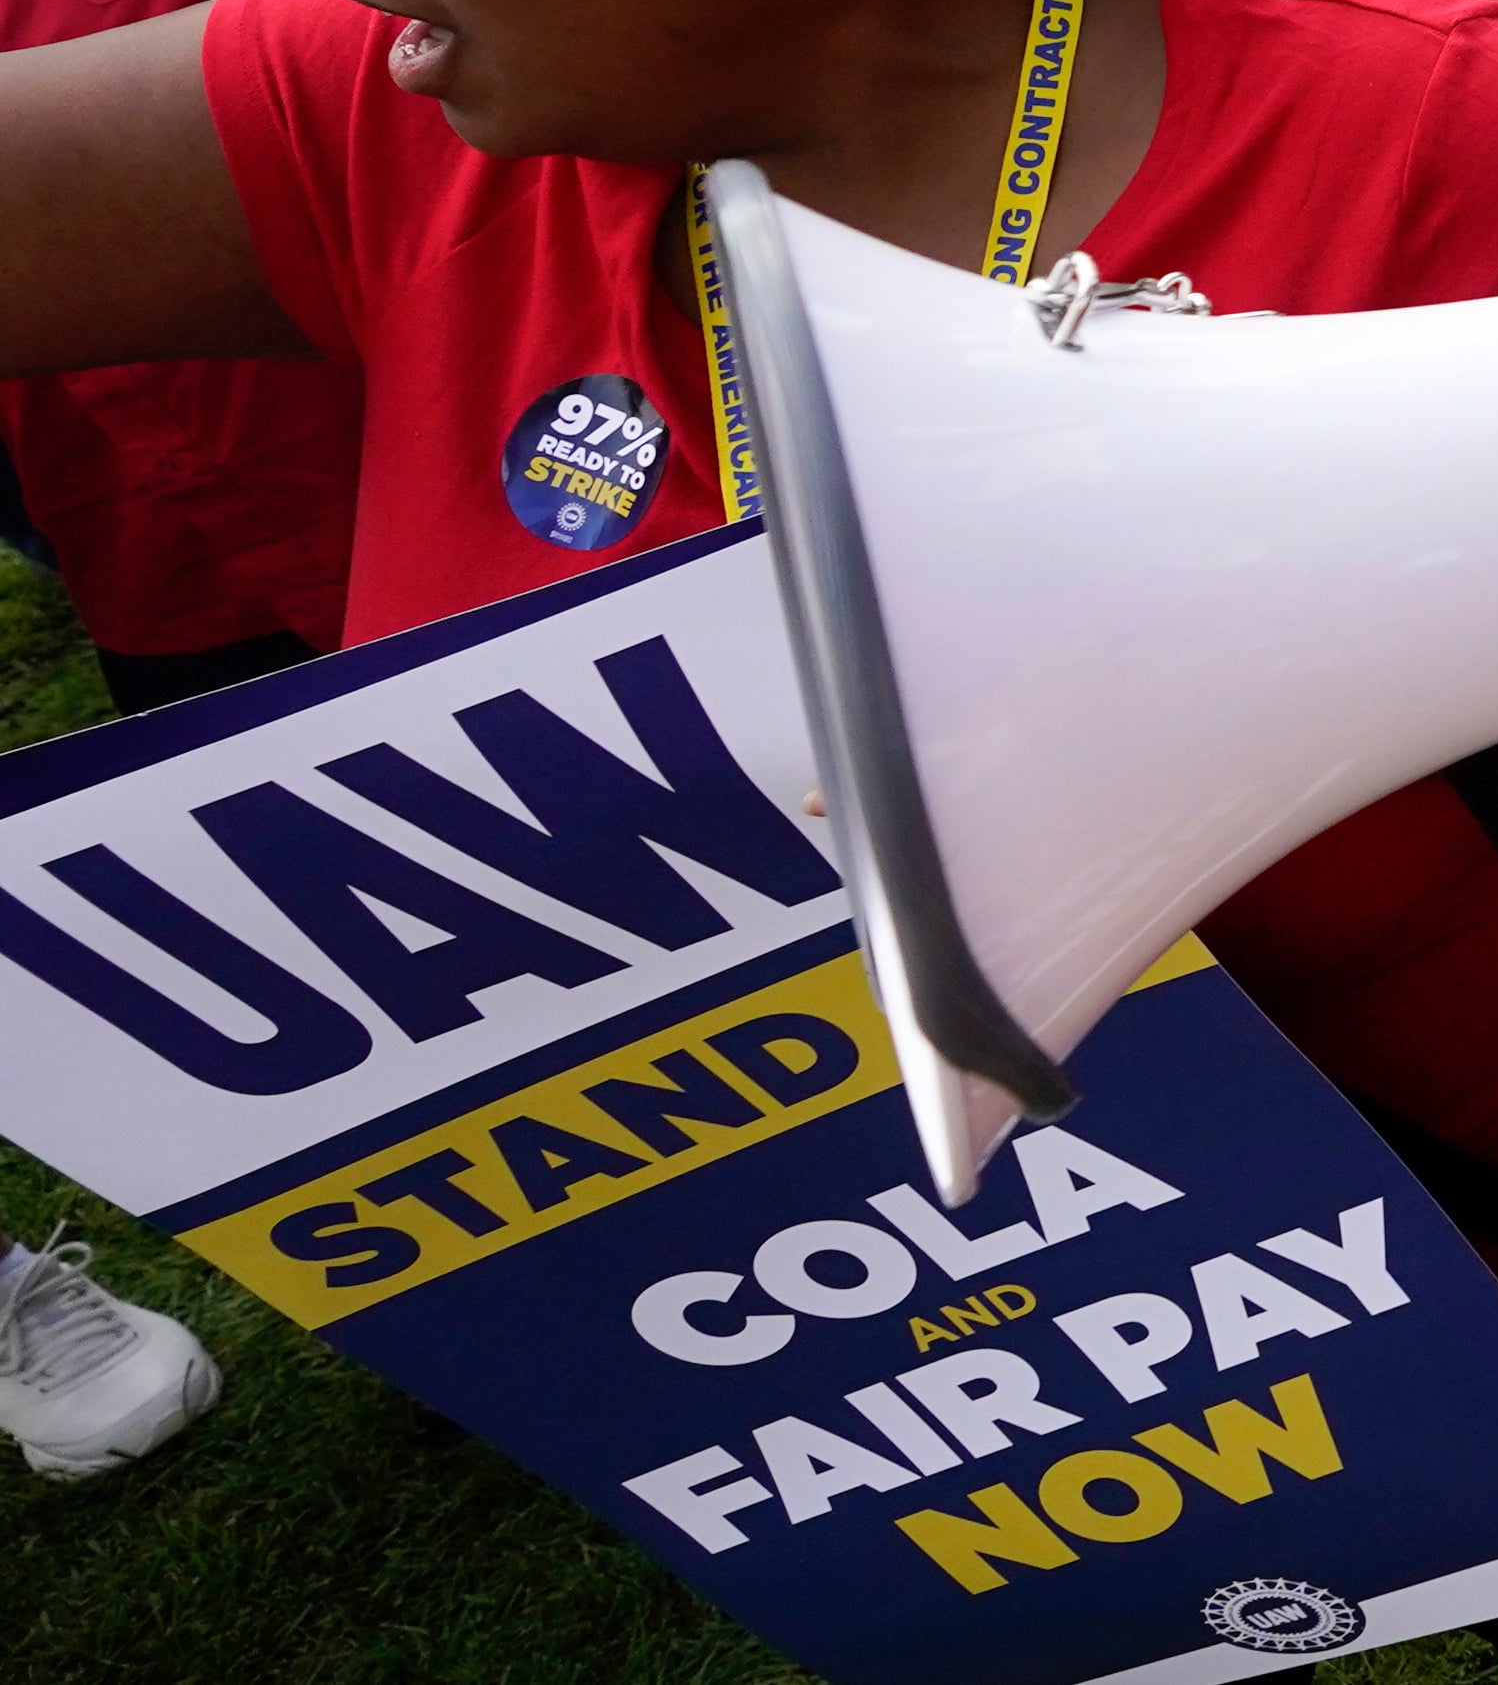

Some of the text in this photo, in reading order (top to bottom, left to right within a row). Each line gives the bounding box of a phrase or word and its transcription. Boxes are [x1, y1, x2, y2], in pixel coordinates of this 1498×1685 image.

[524, 456, 637, 518] STRIKE
[536, 434, 646, 491] READY TO
[550, 393, 664, 468] 97%
[0, 634, 846, 1096] UAW
[269, 1013, 860, 1289] STAND
[631, 1124, 1187, 1367] COLA
[907, 1282, 1038, 1354] AND
[620, 1194, 1412, 1555] FAIR PAY
[893, 1372, 1346, 1596] NOW
[1246, 1602, 1308, 1629] UAW
